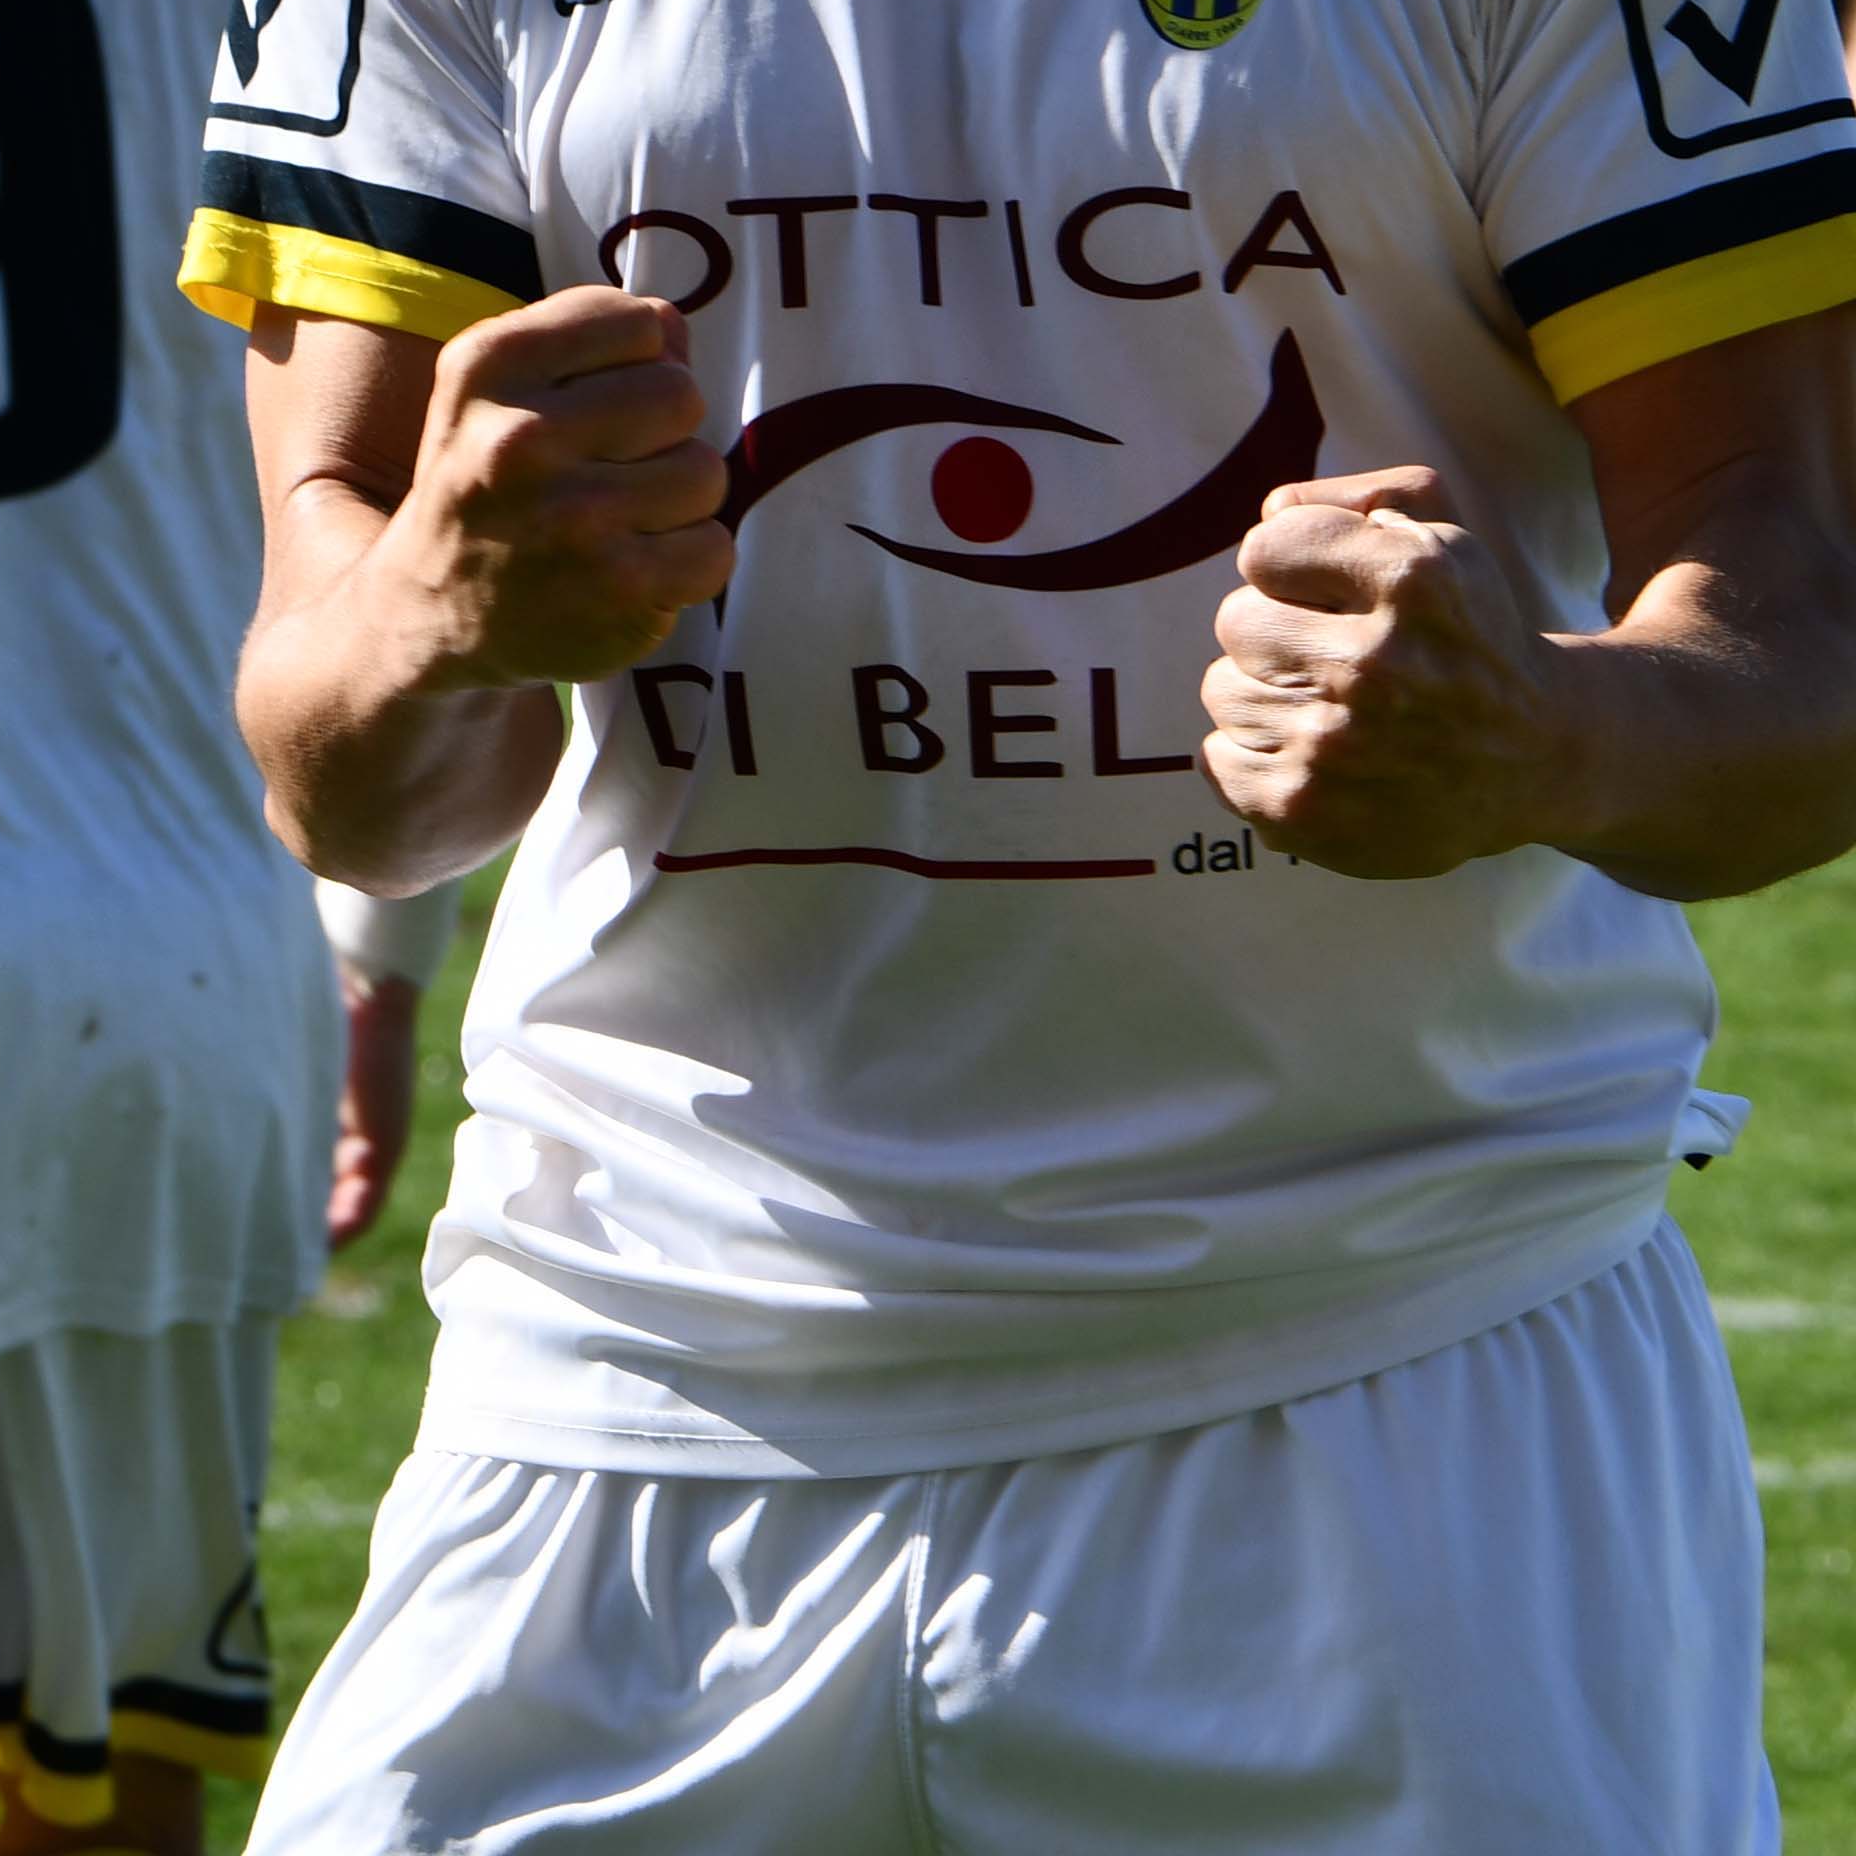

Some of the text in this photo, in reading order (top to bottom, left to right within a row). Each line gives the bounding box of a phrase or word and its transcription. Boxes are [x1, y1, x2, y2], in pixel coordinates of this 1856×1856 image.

[598, 185, 1347, 316] OTTICA
[632, 663, 1196, 780] DI BEL
[1172, 827, 1255, 875] dal
